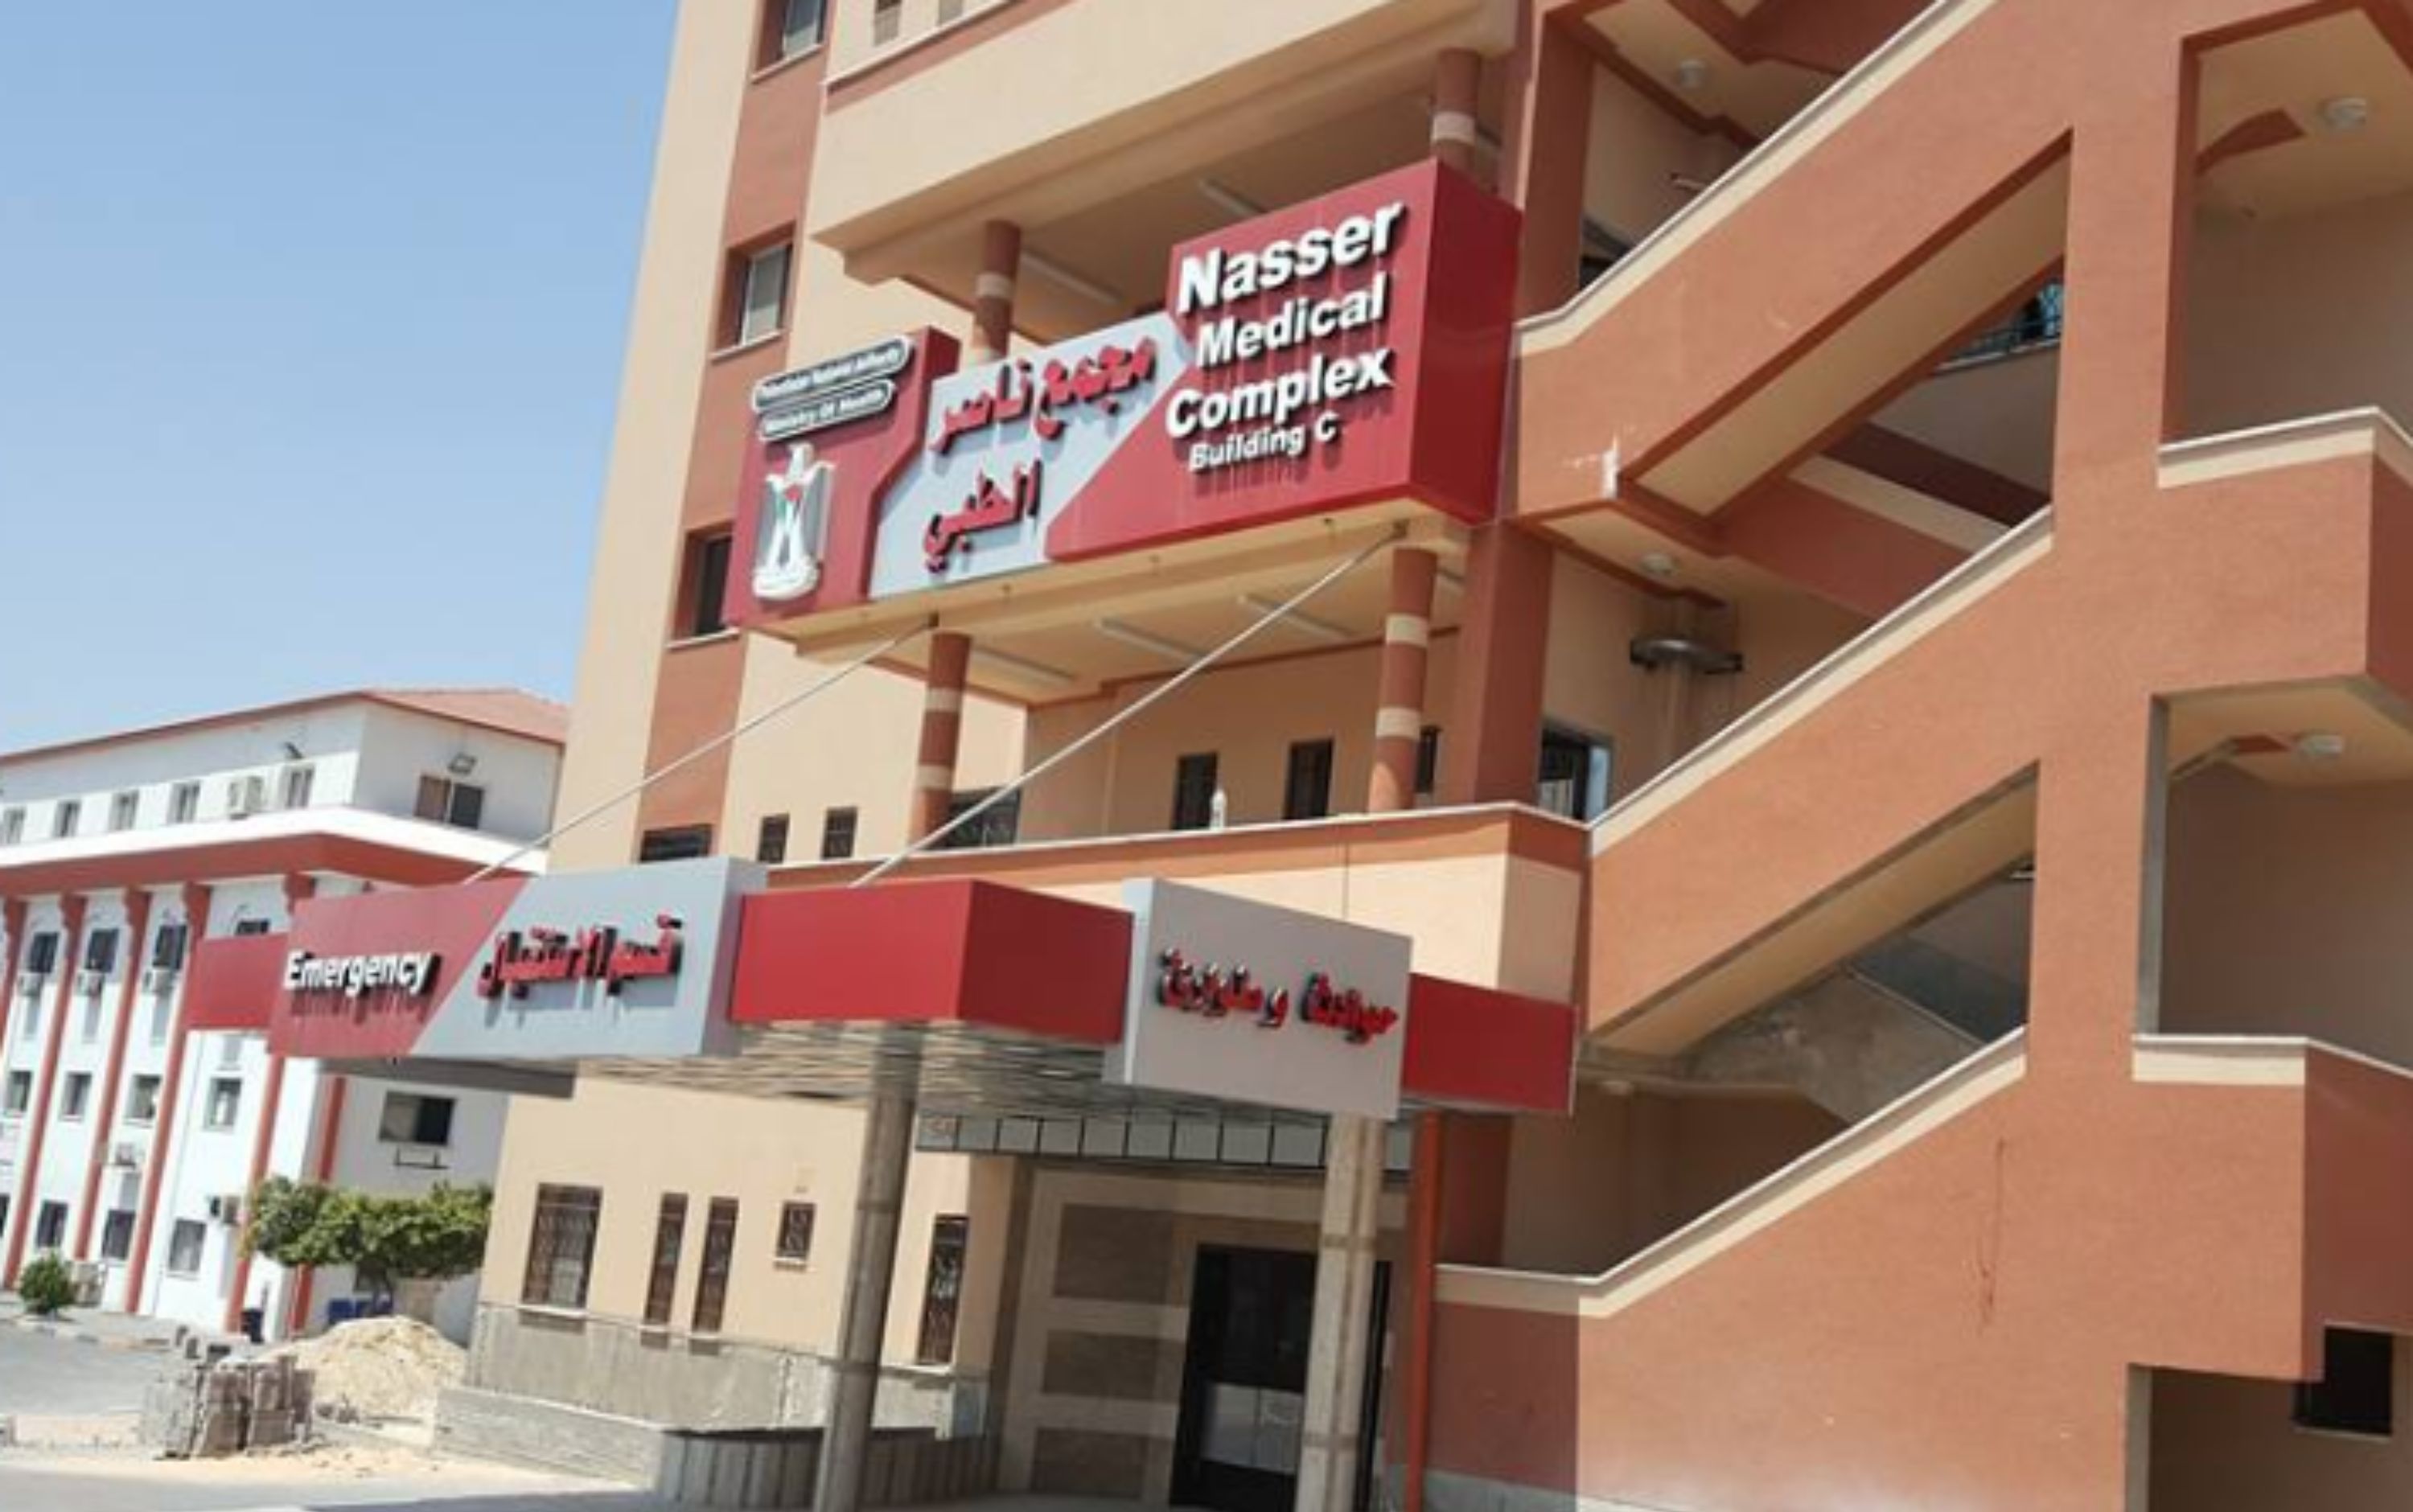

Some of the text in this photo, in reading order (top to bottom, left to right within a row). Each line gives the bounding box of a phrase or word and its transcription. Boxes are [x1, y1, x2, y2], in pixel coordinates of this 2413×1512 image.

[1177, 201, 1404, 314] Nasser
[1196, 271, 1388, 368] Medical
[929, 359, 1034, 456] ناصر
[1035, 336, 1158, 442] مجمع
[1166, 348, 1394, 438] Complex
[1189, 410, 1340, 471] Building C
[924, 458, 1043, 573] الطبي
[284, 950, 433, 998] Emergency
